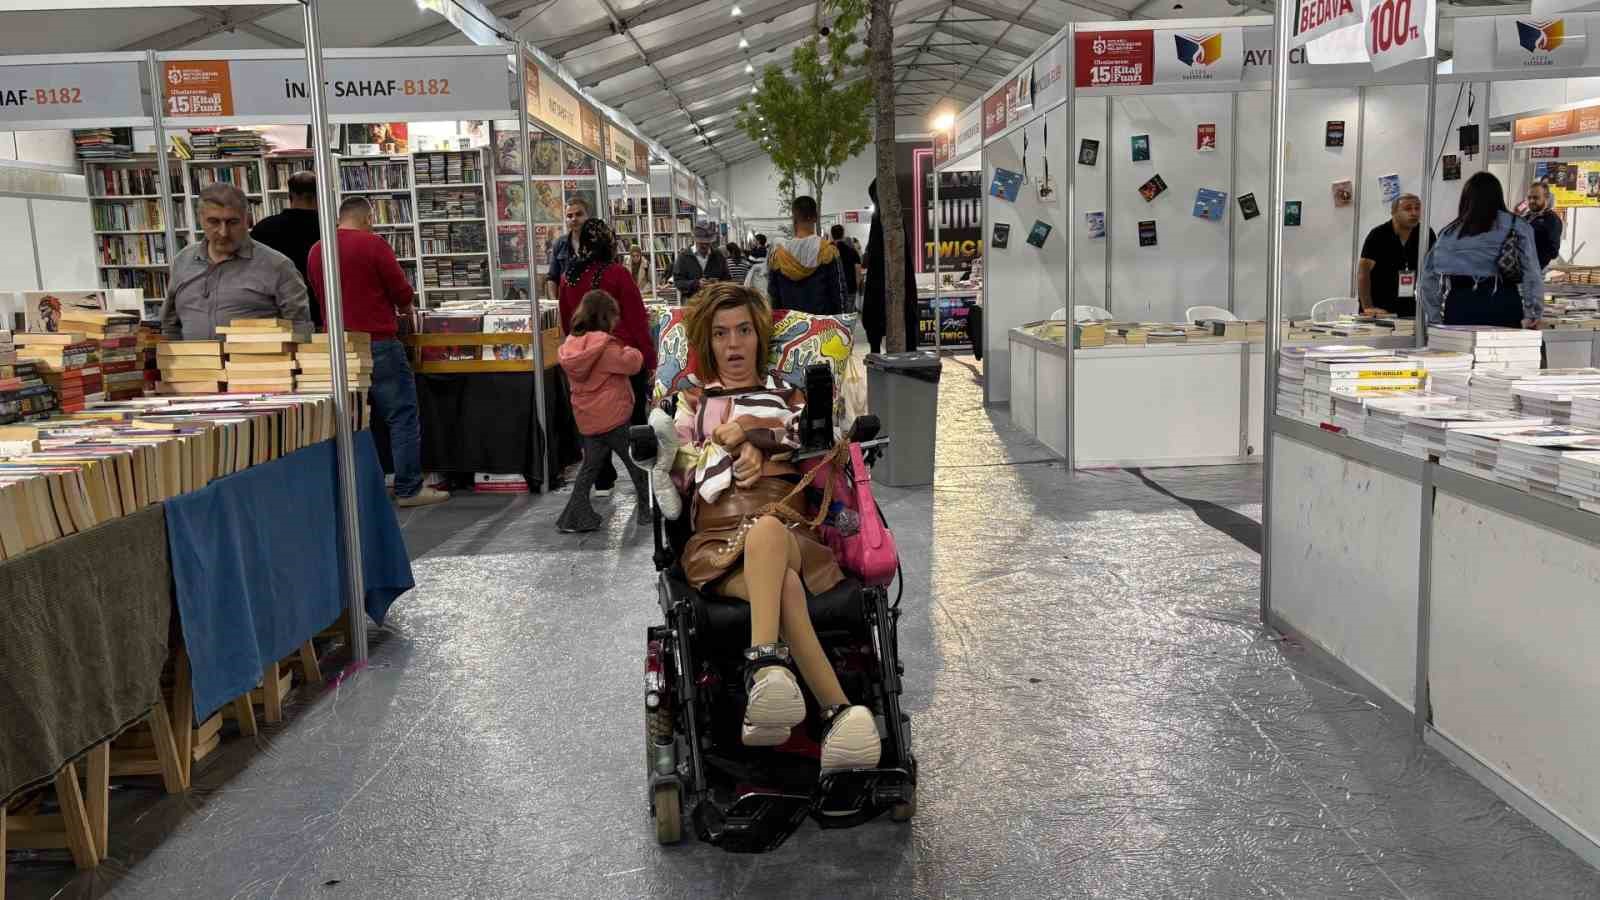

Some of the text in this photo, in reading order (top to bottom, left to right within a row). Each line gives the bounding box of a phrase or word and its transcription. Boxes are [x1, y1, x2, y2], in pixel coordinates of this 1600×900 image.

[1300, 0, 1354, 33] BEDAVA
[1371, 0, 1411, 55] 100
[1089, 66, 1110, 83] 15
[334, 79, 452, 97] SAHAF-B182
[168, 95, 190, 113] 15
